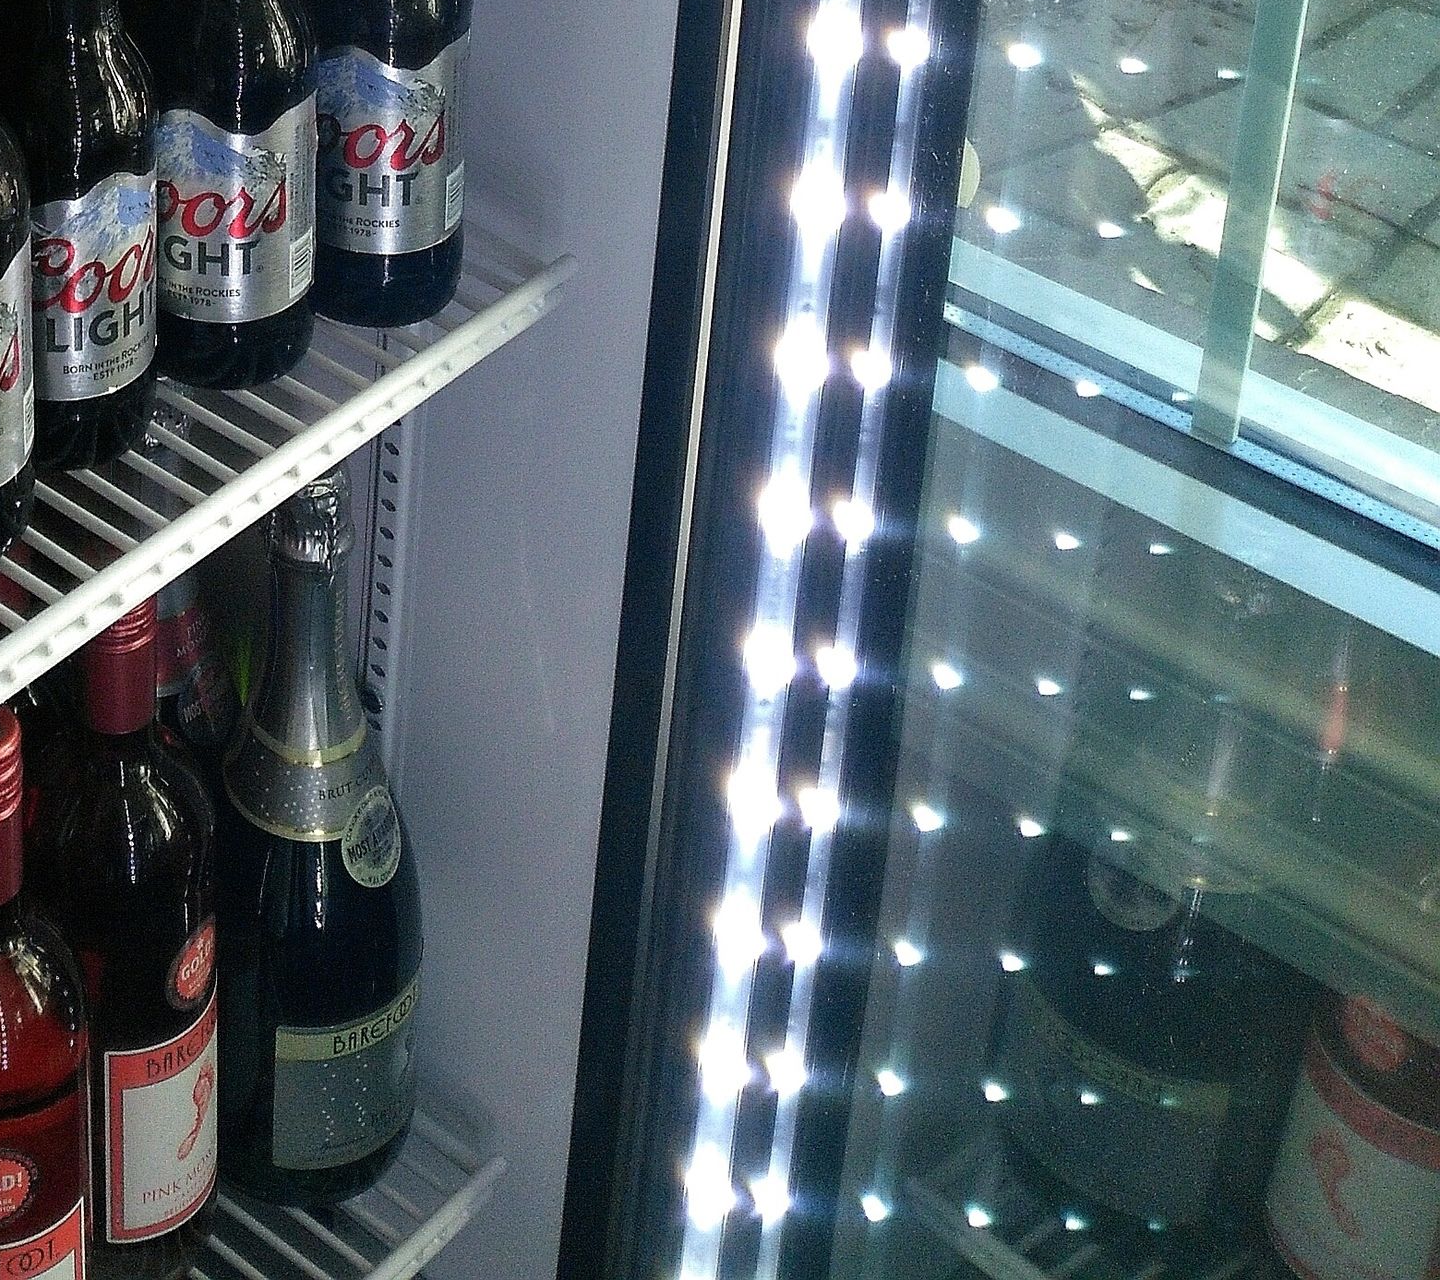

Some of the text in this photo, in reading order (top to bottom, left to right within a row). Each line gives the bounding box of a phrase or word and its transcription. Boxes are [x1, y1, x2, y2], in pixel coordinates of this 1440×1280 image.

[356, 217, 401, 228] ROCKIES
[32, 223, 156, 314] Coor
[164, 239, 260, 277] GHT
[195, 286, 241, 298] ROCKIES
[63, 363, 93, 375] BORN
[105, 356, 120, 368] THE
[319, 781, 354, 802] BRUT
[333, 985, 419, 1055] BAREFOOT
